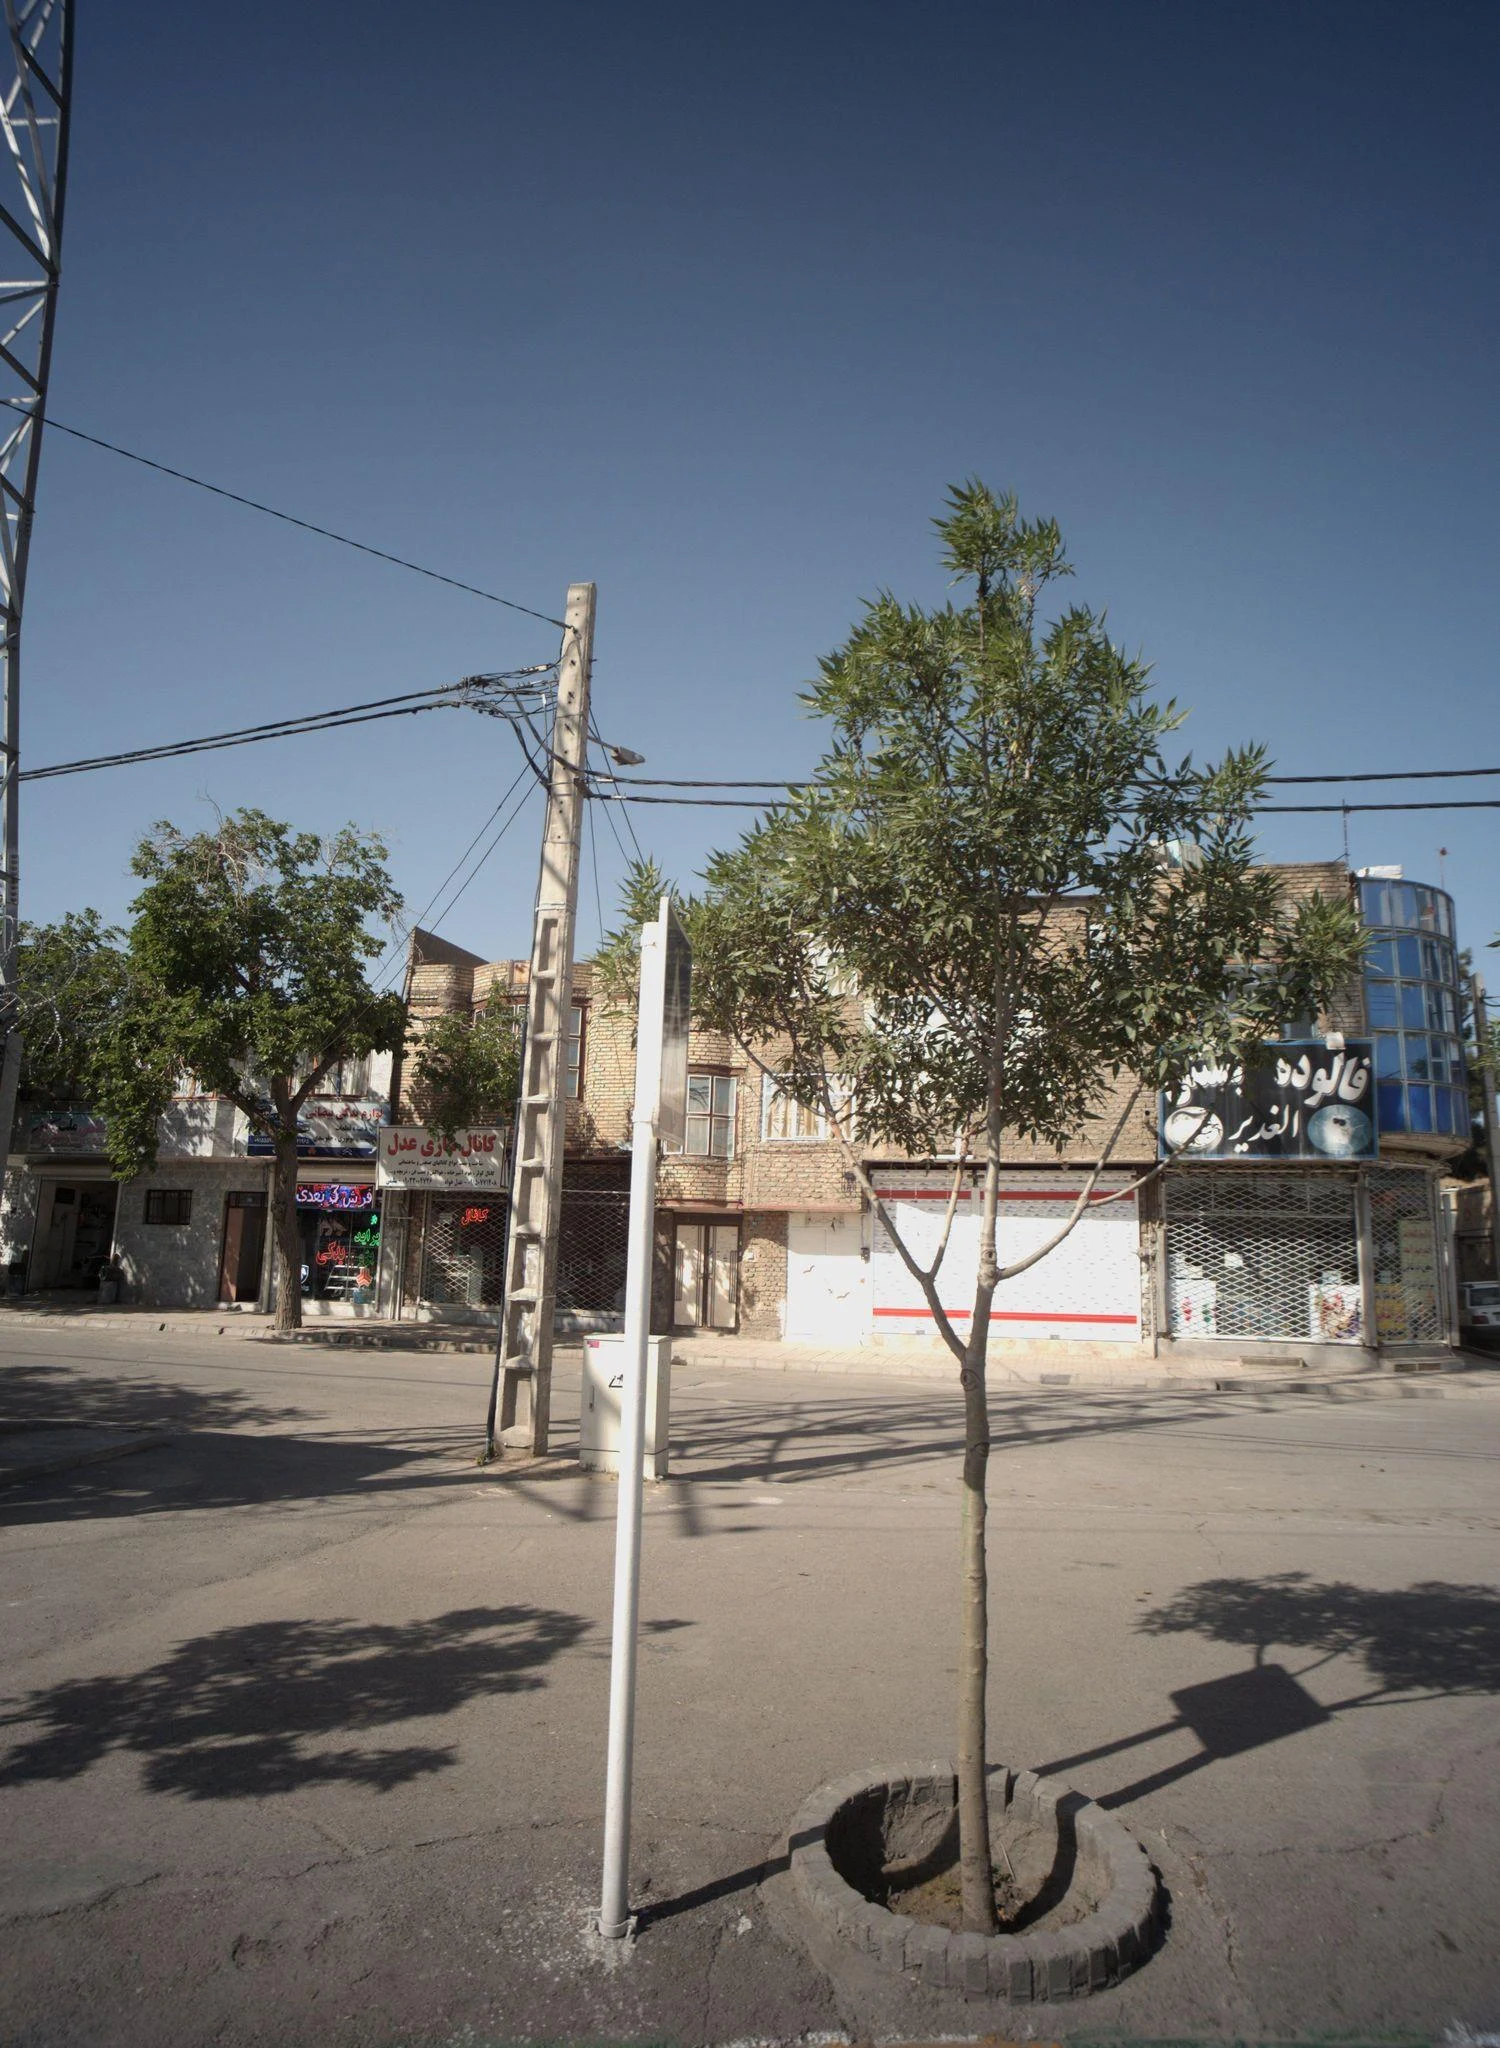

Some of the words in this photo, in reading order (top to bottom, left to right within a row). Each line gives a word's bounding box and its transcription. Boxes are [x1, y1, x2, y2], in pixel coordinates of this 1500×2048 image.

[1275, 1052, 1370, 1108] فالوده
[1228, 1104, 1299, 1153] الغدیر
[387, 1133, 417, 1156] عدل
[461, 1133, 497, 1157] کانال
[296, 1189, 325, 1206] بعدی
[343, 1188, 373, 1208] فرش
[461, 1208, 489, 1226] کانال
